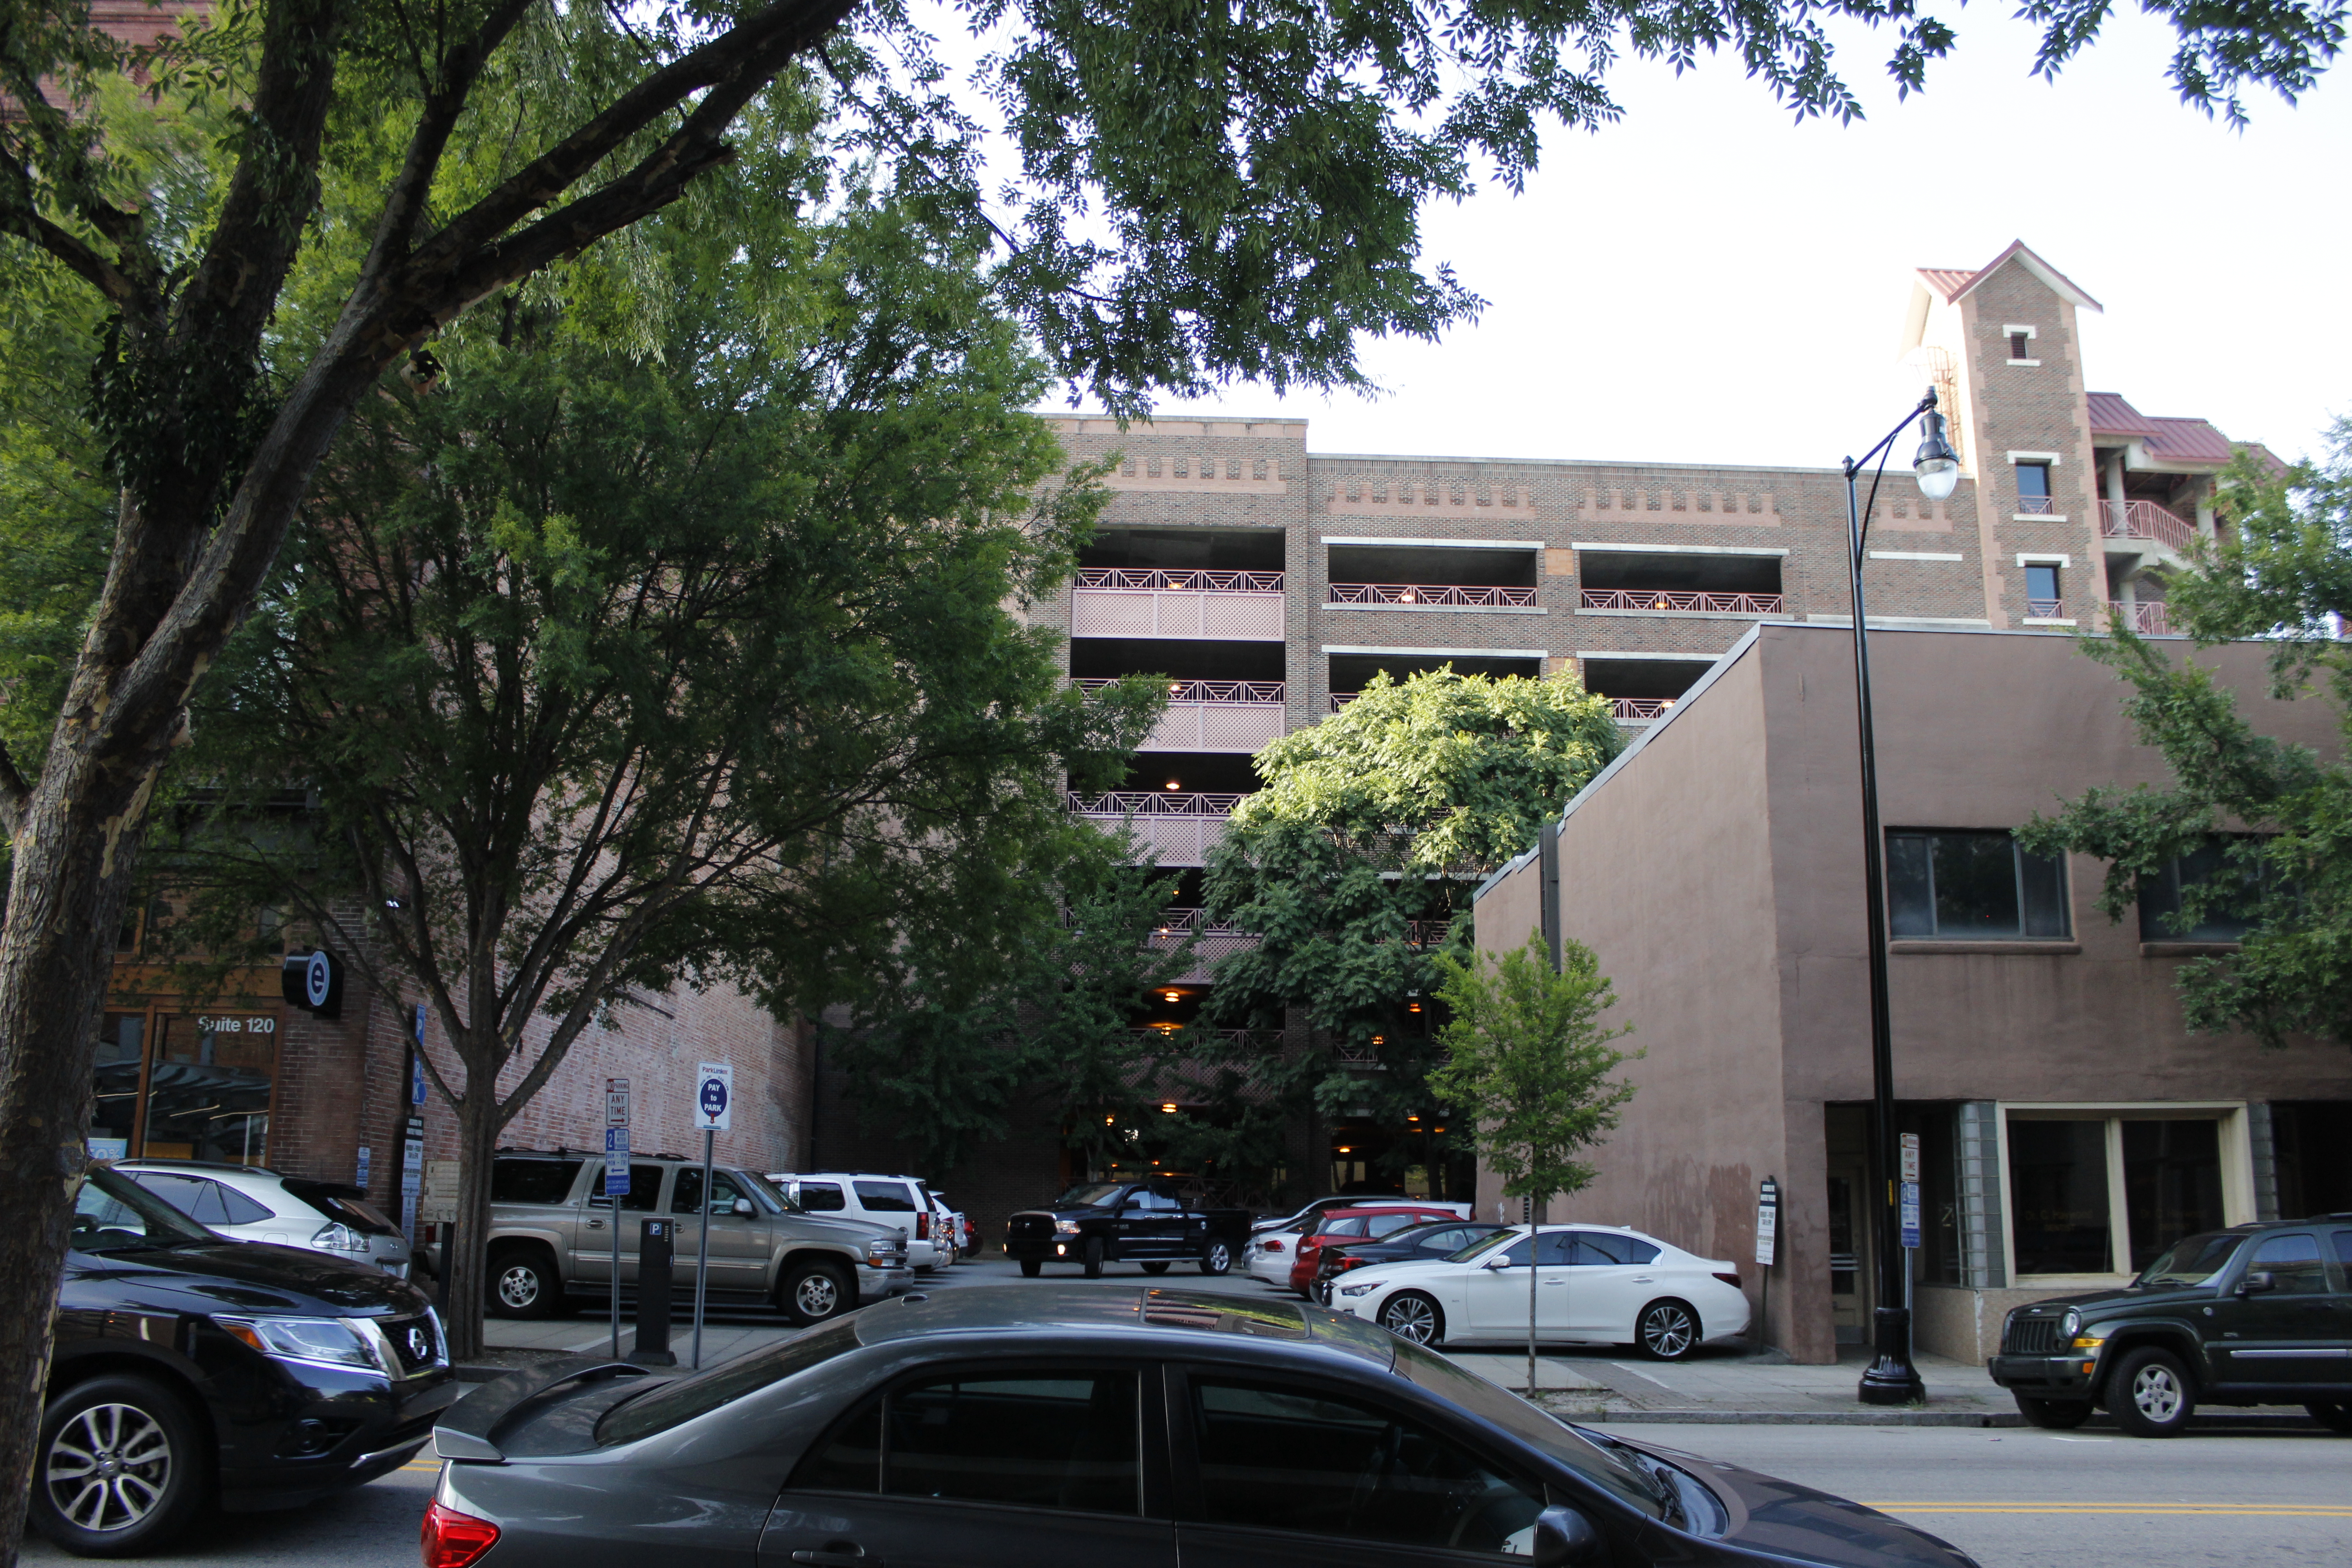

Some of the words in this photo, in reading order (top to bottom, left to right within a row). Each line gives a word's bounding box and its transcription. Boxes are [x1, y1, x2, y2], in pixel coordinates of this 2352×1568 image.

[311, 962, 325, 995] e
[198, 1016, 241, 1032] Suite
[246, 1018, 275, 1033] 120
[413, 1018, 423, 1100] PRK
[702, 1066, 724, 1074] ParkLink
[607, 1081, 614, 1090] NO
[708, 1083, 721, 1092] PAY
[611, 1094, 625, 1104] ANY
[610, 1106, 626, 1116] TIME
[704, 1103, 722, 1112] PARK
[608, 1133, 613, 1148] 2
[1905, 1150, 1915, 1159] ANY
[652, 1224, 660, 1234] P
